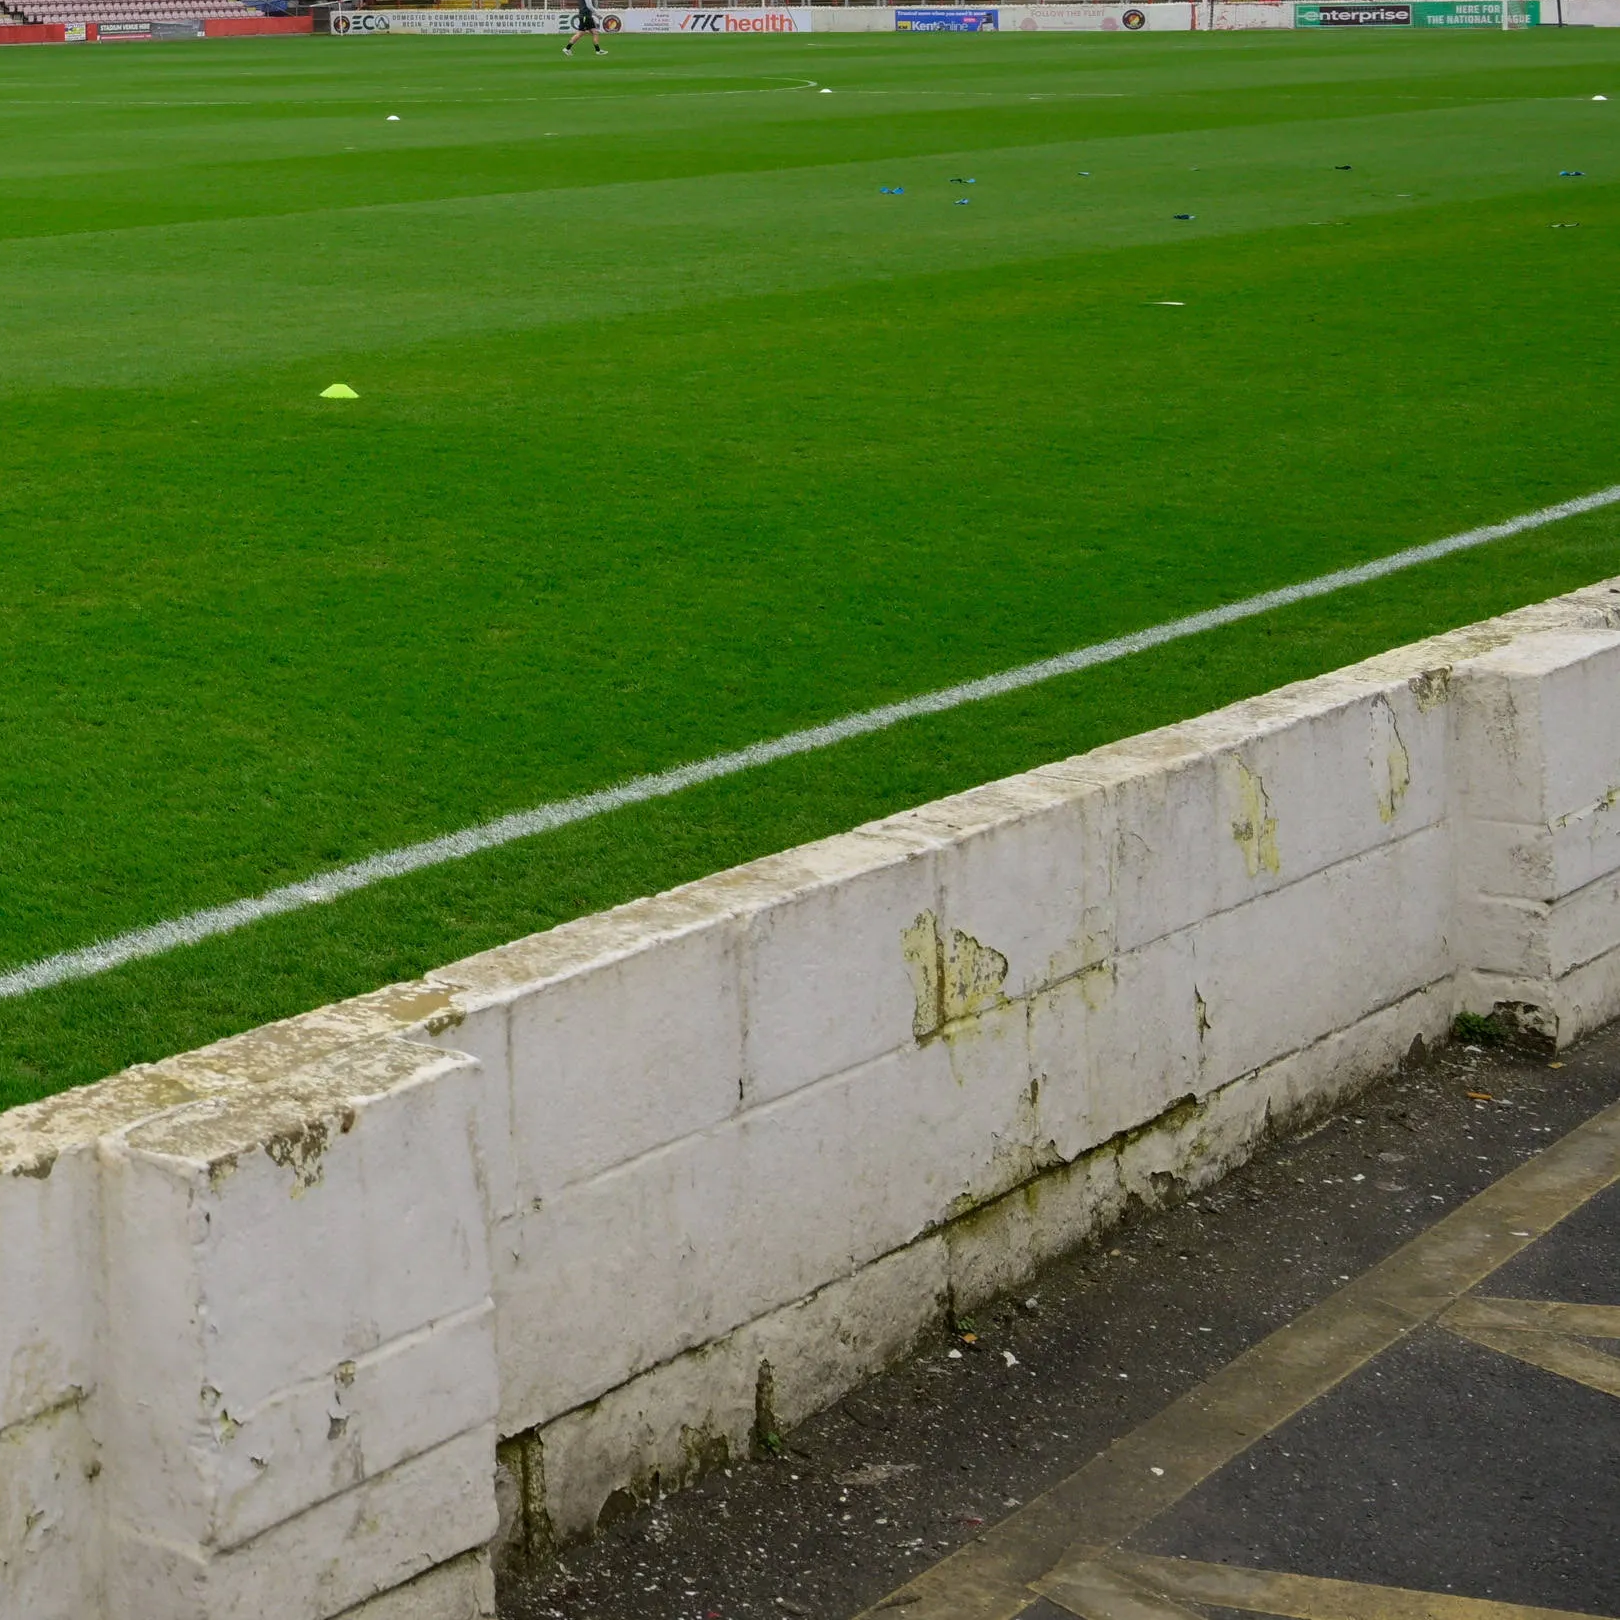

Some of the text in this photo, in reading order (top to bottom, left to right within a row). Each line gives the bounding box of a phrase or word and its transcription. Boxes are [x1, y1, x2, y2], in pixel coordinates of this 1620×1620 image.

[1065, 9, 1080, 17] THE
[1456, 4, 1501, 14] HERE FOR
[1299, 8, 1409, 23] enterprise
[1427, 14, 1531, 25] THE NATIONAL LAGUE
